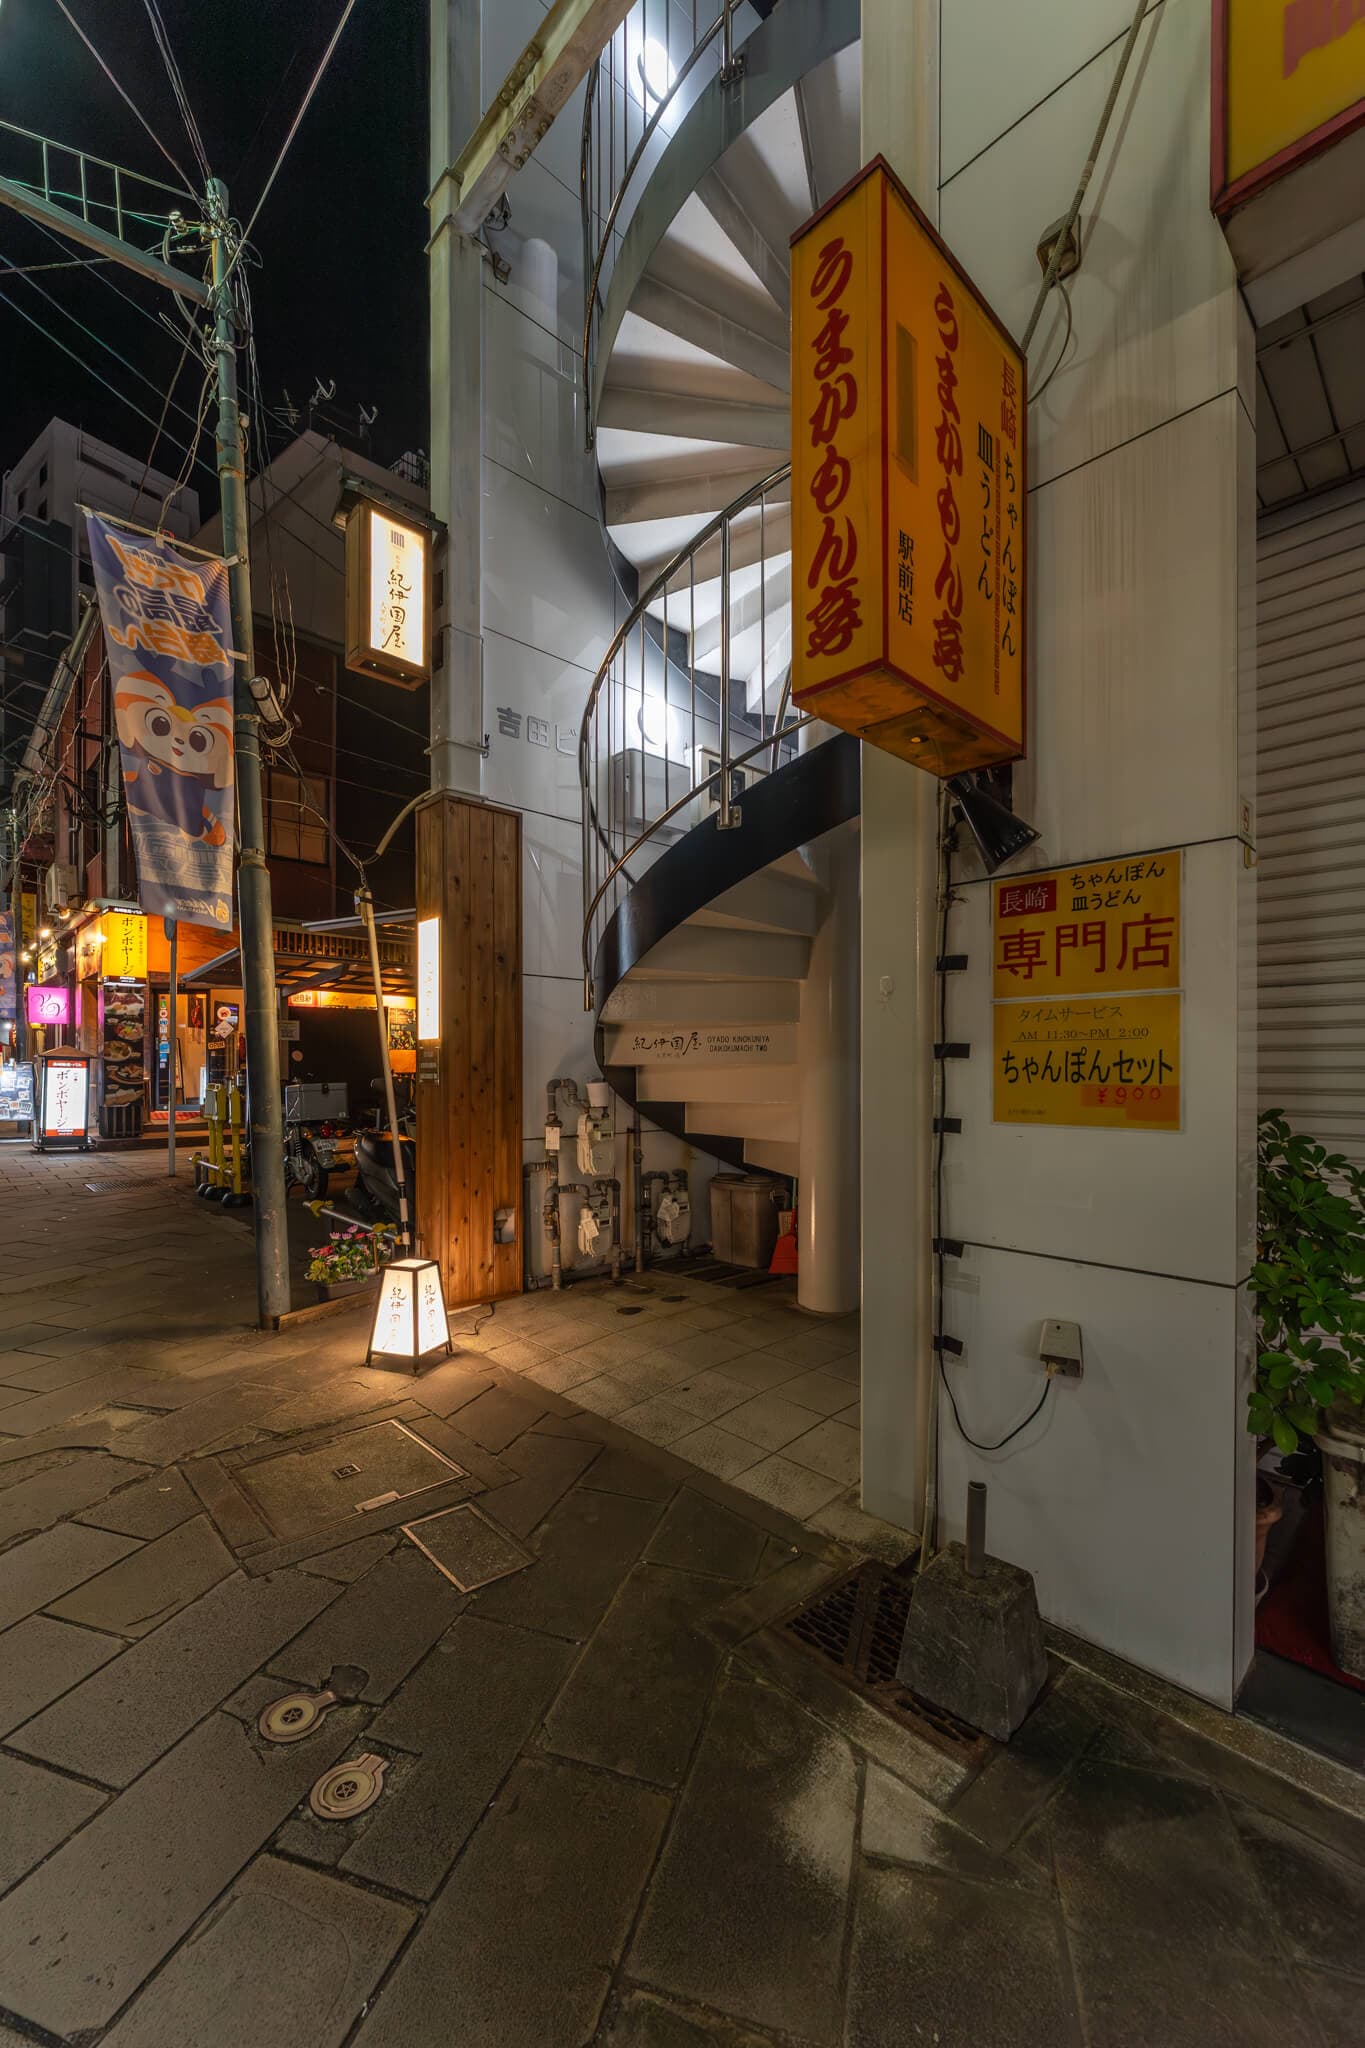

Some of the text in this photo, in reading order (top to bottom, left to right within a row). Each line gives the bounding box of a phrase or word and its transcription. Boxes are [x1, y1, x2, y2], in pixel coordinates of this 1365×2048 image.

[977, 421, 996, 600] 皿うどん
[897, 529, 914, 625] 駅前店
[1070, 861, 1165, 890] ちゃんぽん
[1002, 887, 1049, 914] 長崎
[1071, 889, 1141, 912] 皿うどん
[997, 912, 1175, 980] 専門店
[1018, 1006, 1123, 1024] タイムサービス
[707, 1036, 730, 1044] OYADO
[1018, 1031, 1038, 1040] AM
[1119, 1027, 1149, 1038] 2:00
[1002, 1046, 1173, 1084] ちゃんぽんセット
